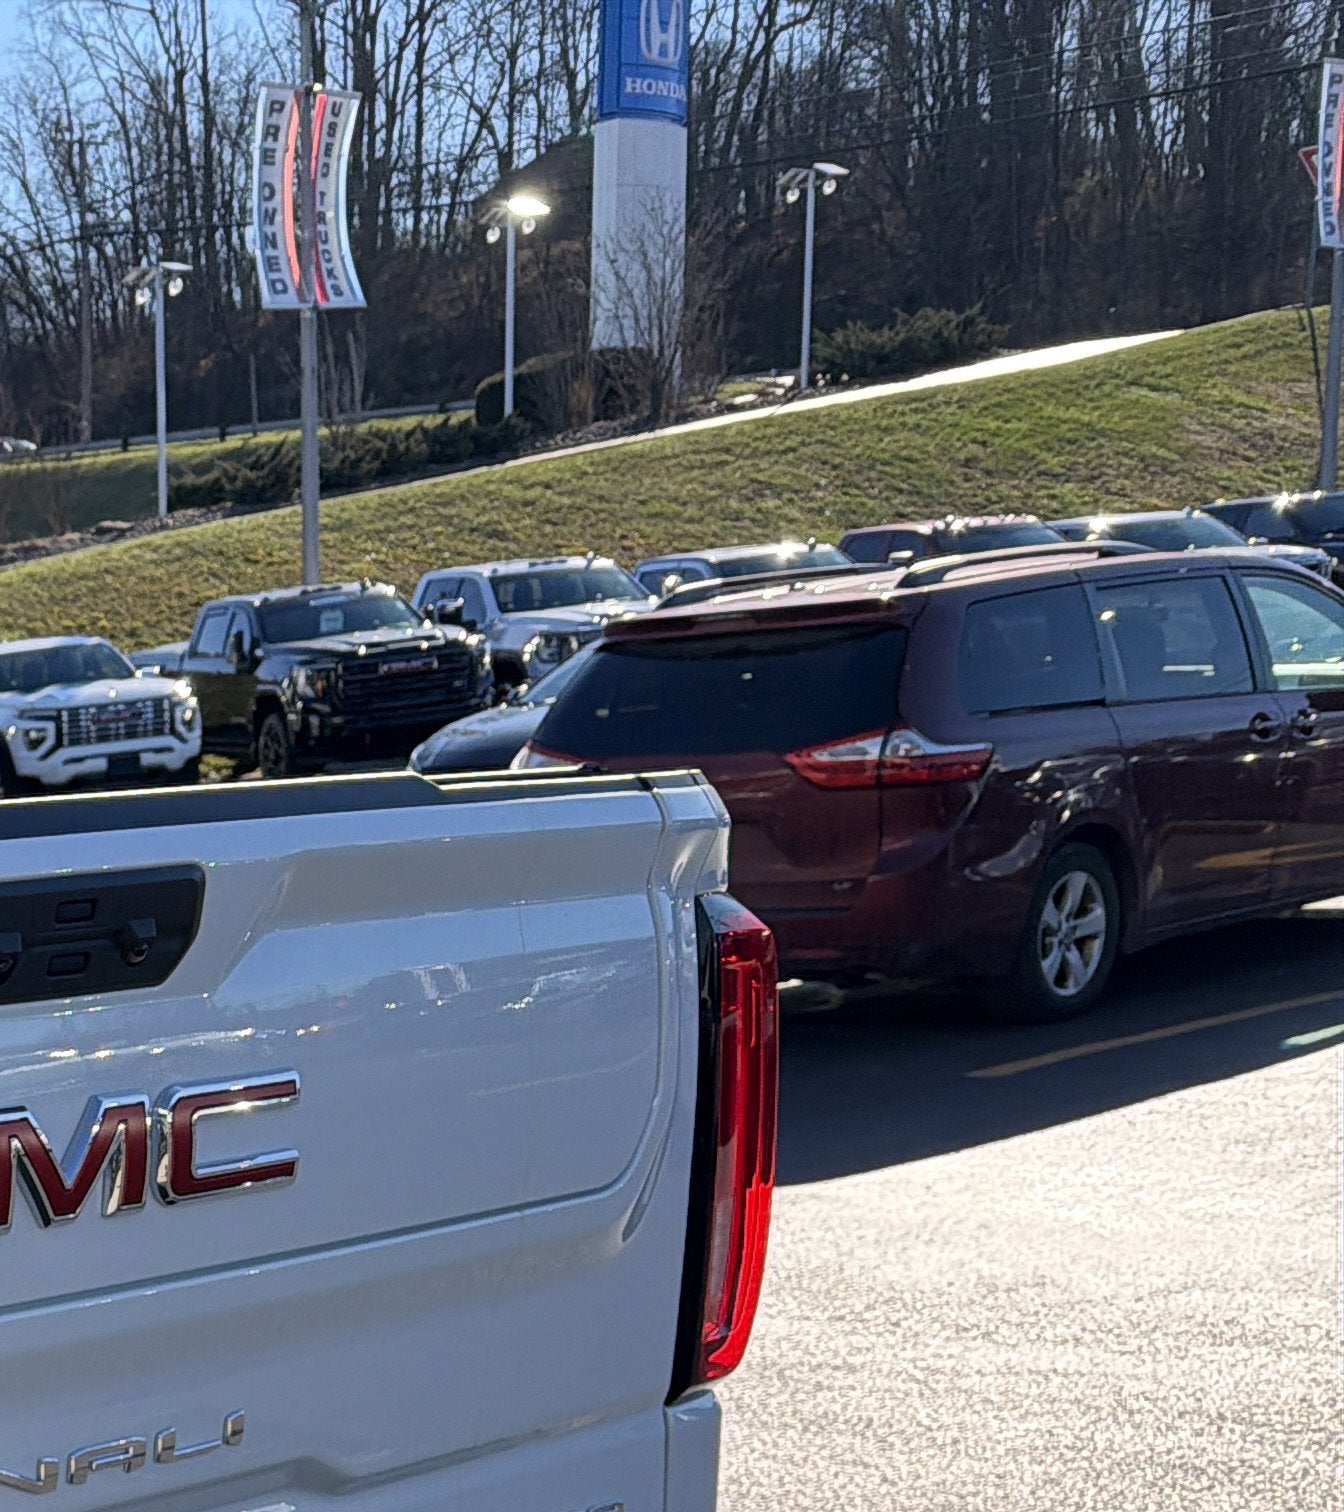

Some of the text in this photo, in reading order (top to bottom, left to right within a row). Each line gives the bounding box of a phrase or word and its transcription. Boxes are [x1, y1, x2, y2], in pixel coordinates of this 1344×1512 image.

[624, 76, 687, 100] HONDA
[262, 99, 289, 296] PRE OWNED
[317, 100, 345, 298] USED TRUCKS
